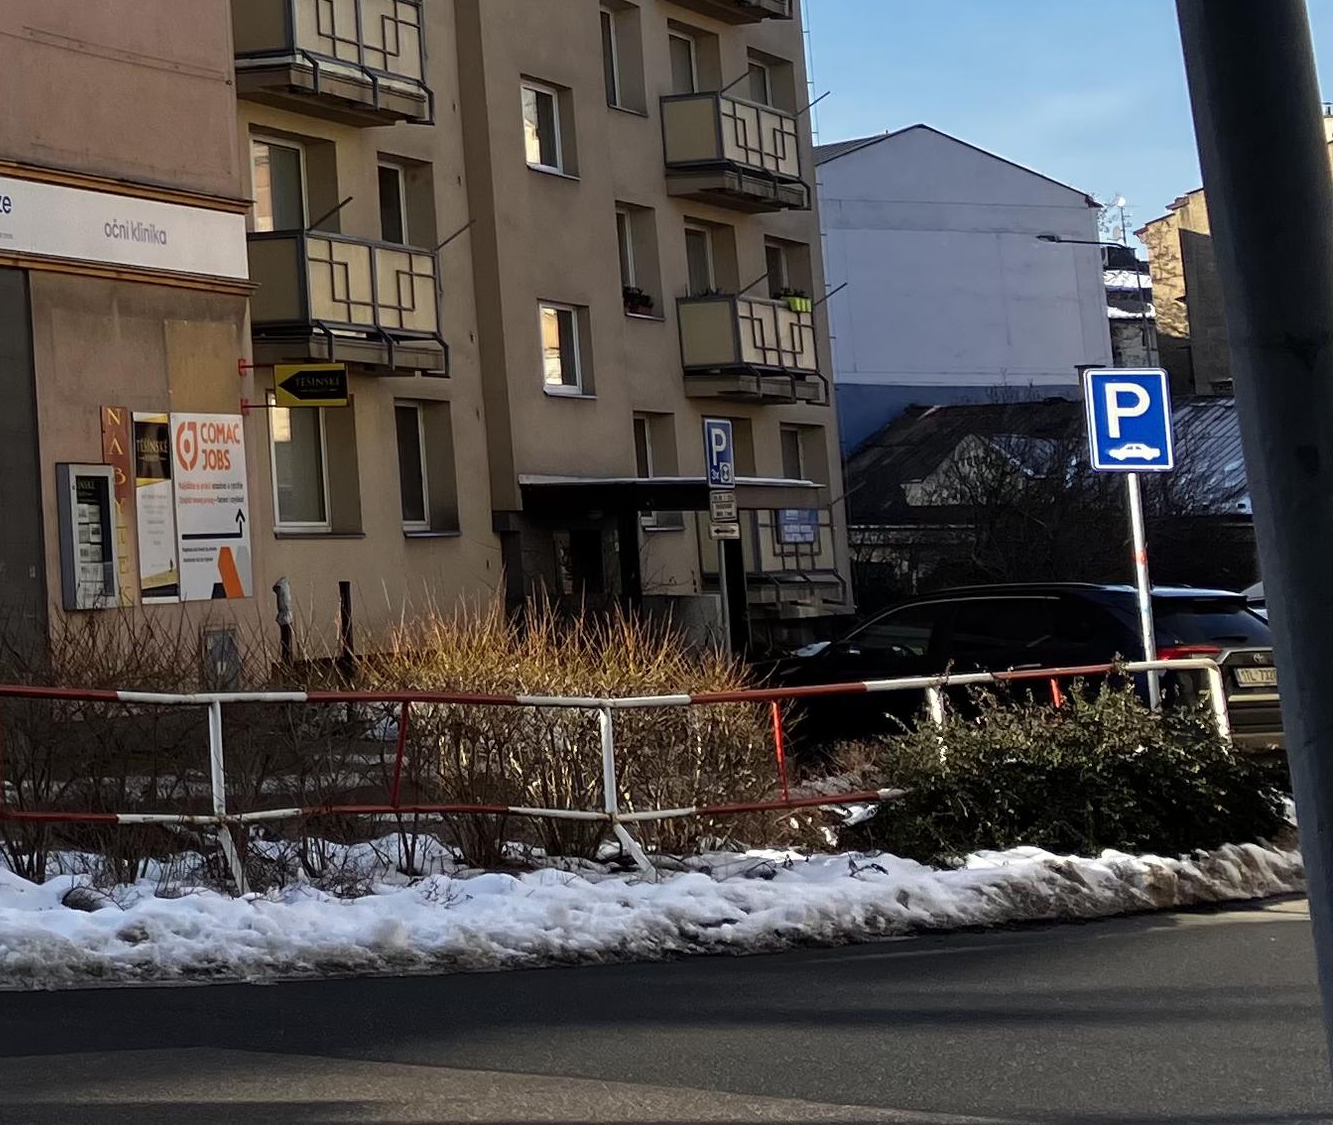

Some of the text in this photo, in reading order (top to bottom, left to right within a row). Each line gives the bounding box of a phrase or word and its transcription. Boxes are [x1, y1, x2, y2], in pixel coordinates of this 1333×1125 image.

[132, 220, 168, 246] klinika
[1104, 383, 1151, 438] P
[200, 422, 241, 445] COMAC
[711, 428, 727, 466] P
[201, 449, 231, 472] JOBS
